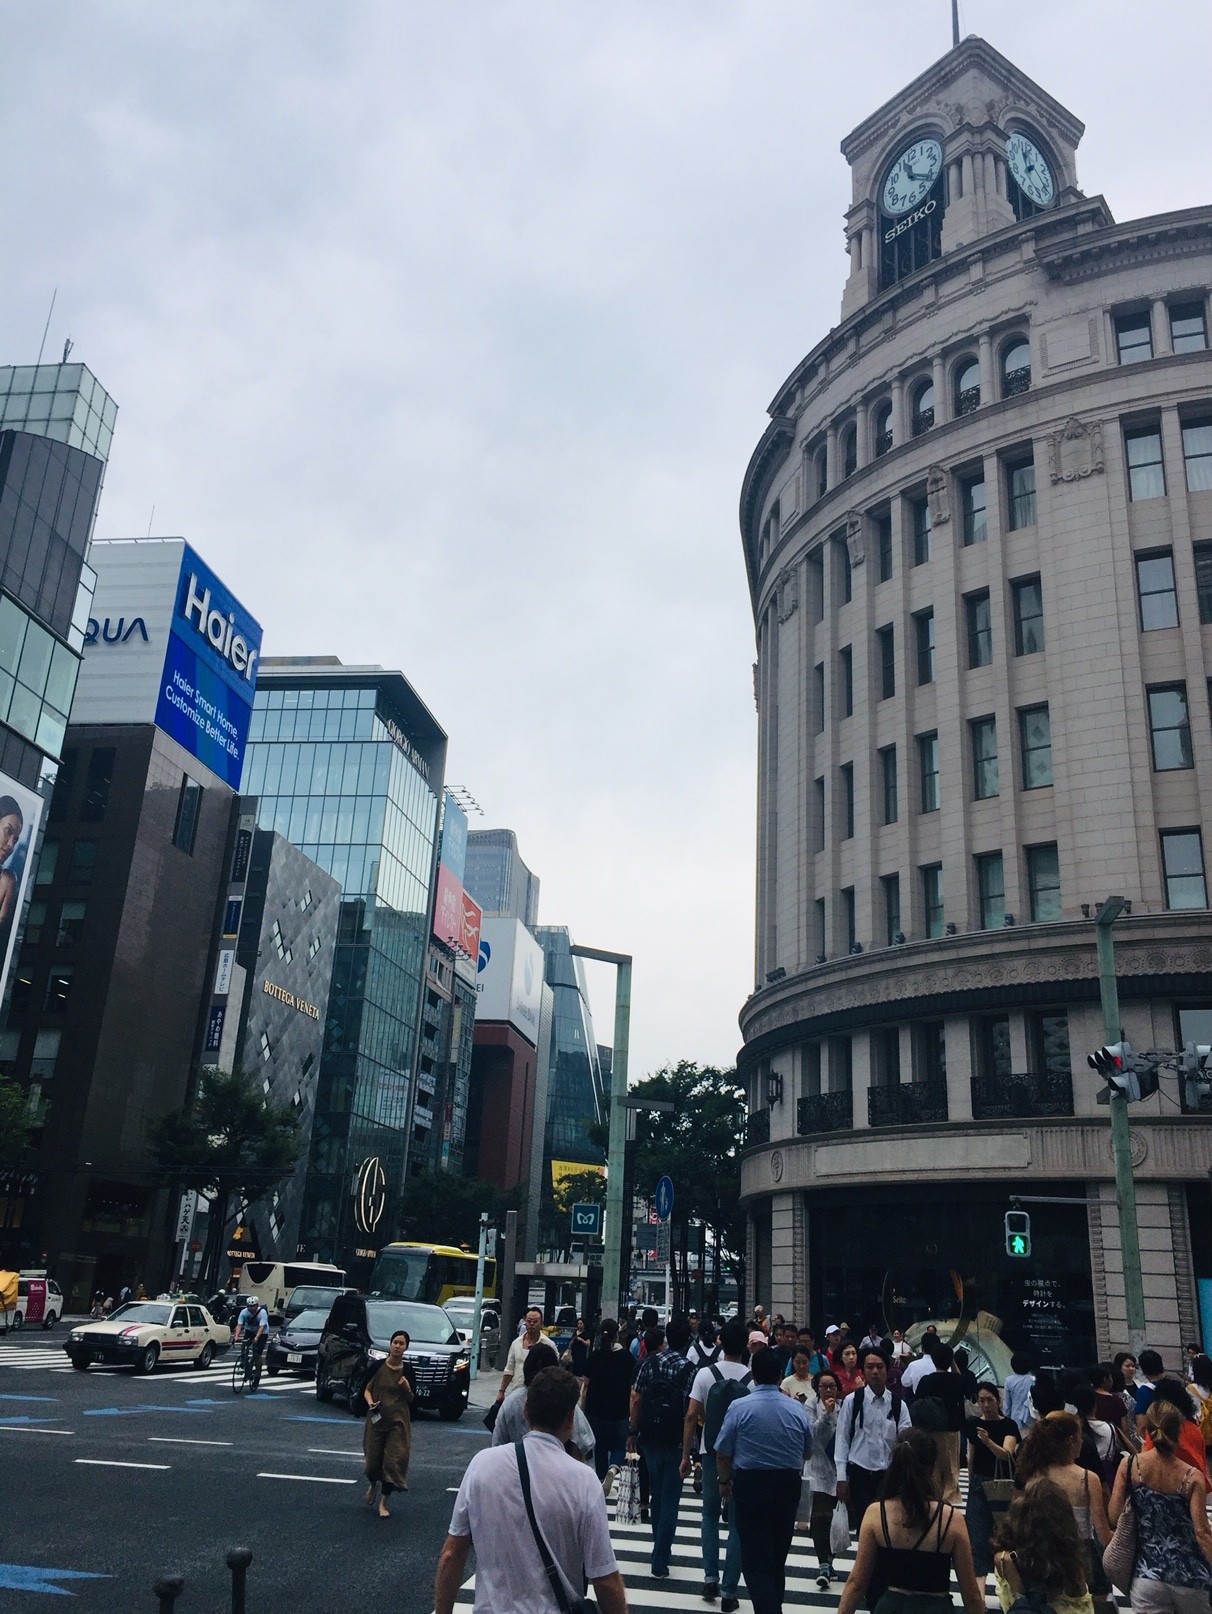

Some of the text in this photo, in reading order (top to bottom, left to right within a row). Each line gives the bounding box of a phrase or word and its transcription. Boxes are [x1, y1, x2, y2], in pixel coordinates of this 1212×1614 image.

[907, 149, 917, 163] 12
[920, 146, 924, 156] 1
[926, 146, 933, 159] 2
[1009, 149, 1015, 161] 9
[930, 154, 937, 167] 3
[1012, 163, 1019, 174] 8
[1040, 163, 1046, 176] 2
[890, 172, 899, 185] 10
[1020, 175, 1026, 186] 7
[1043, 177, 1049, 188] 3
[888, 186, 895, 198] 9
[919, 181, 926, 195] 5
[1027, 185, 1033, 196] 6
[891, 194, 899, 206] 8
[900, 194, 907, 207] 7
[908, 191, 916, 203] 6
[885, 200, 937, 244] SEIKO
[85, 617, 149, 642] QUA
[184, 571, 258, 681] Haier
[173, 669, 239, 740] Haier Smart Home,
[166, 685, 240, 761] Customize Better Life.
[263, 979, 320, 1021] BOTTEGA VENETA
[1033, 1289, 1053, 1298] 時計を
[1022, 1299, 1066, 1309] デザインする。
